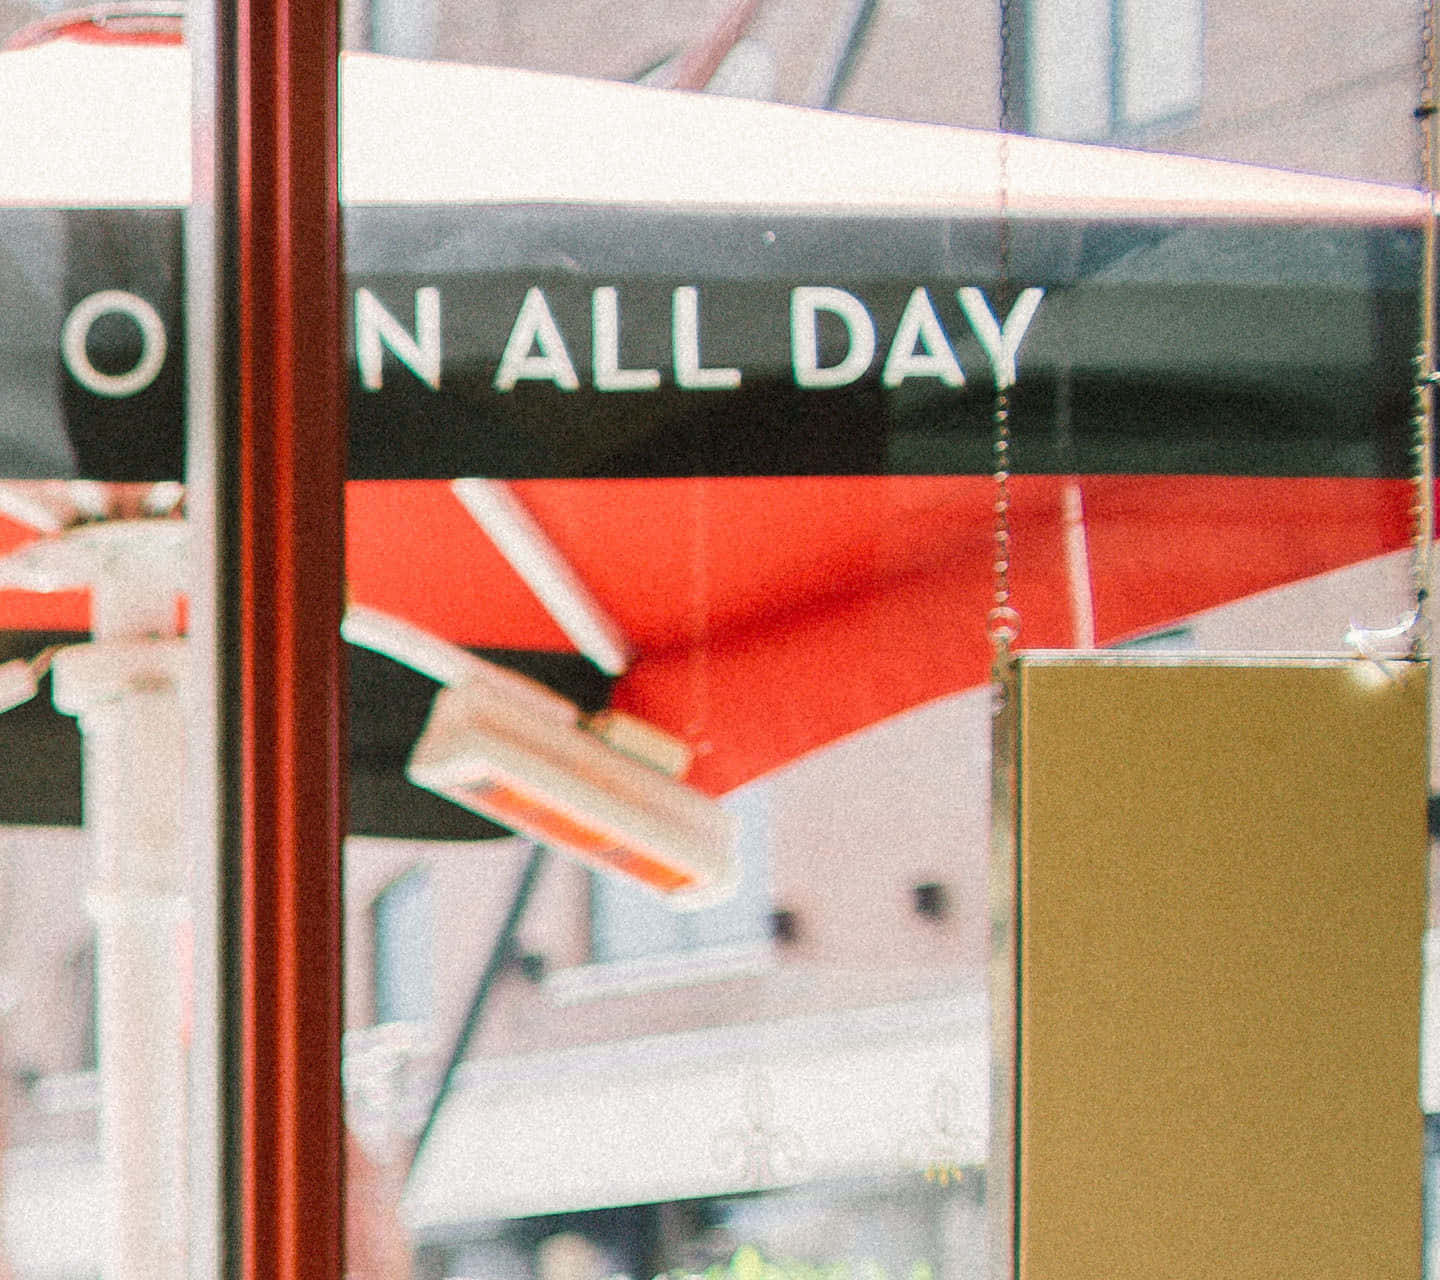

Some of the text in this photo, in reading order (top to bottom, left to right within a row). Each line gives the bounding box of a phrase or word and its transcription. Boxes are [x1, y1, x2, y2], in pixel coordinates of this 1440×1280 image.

[59, 285, 1047, 398] ON ALL DAY
